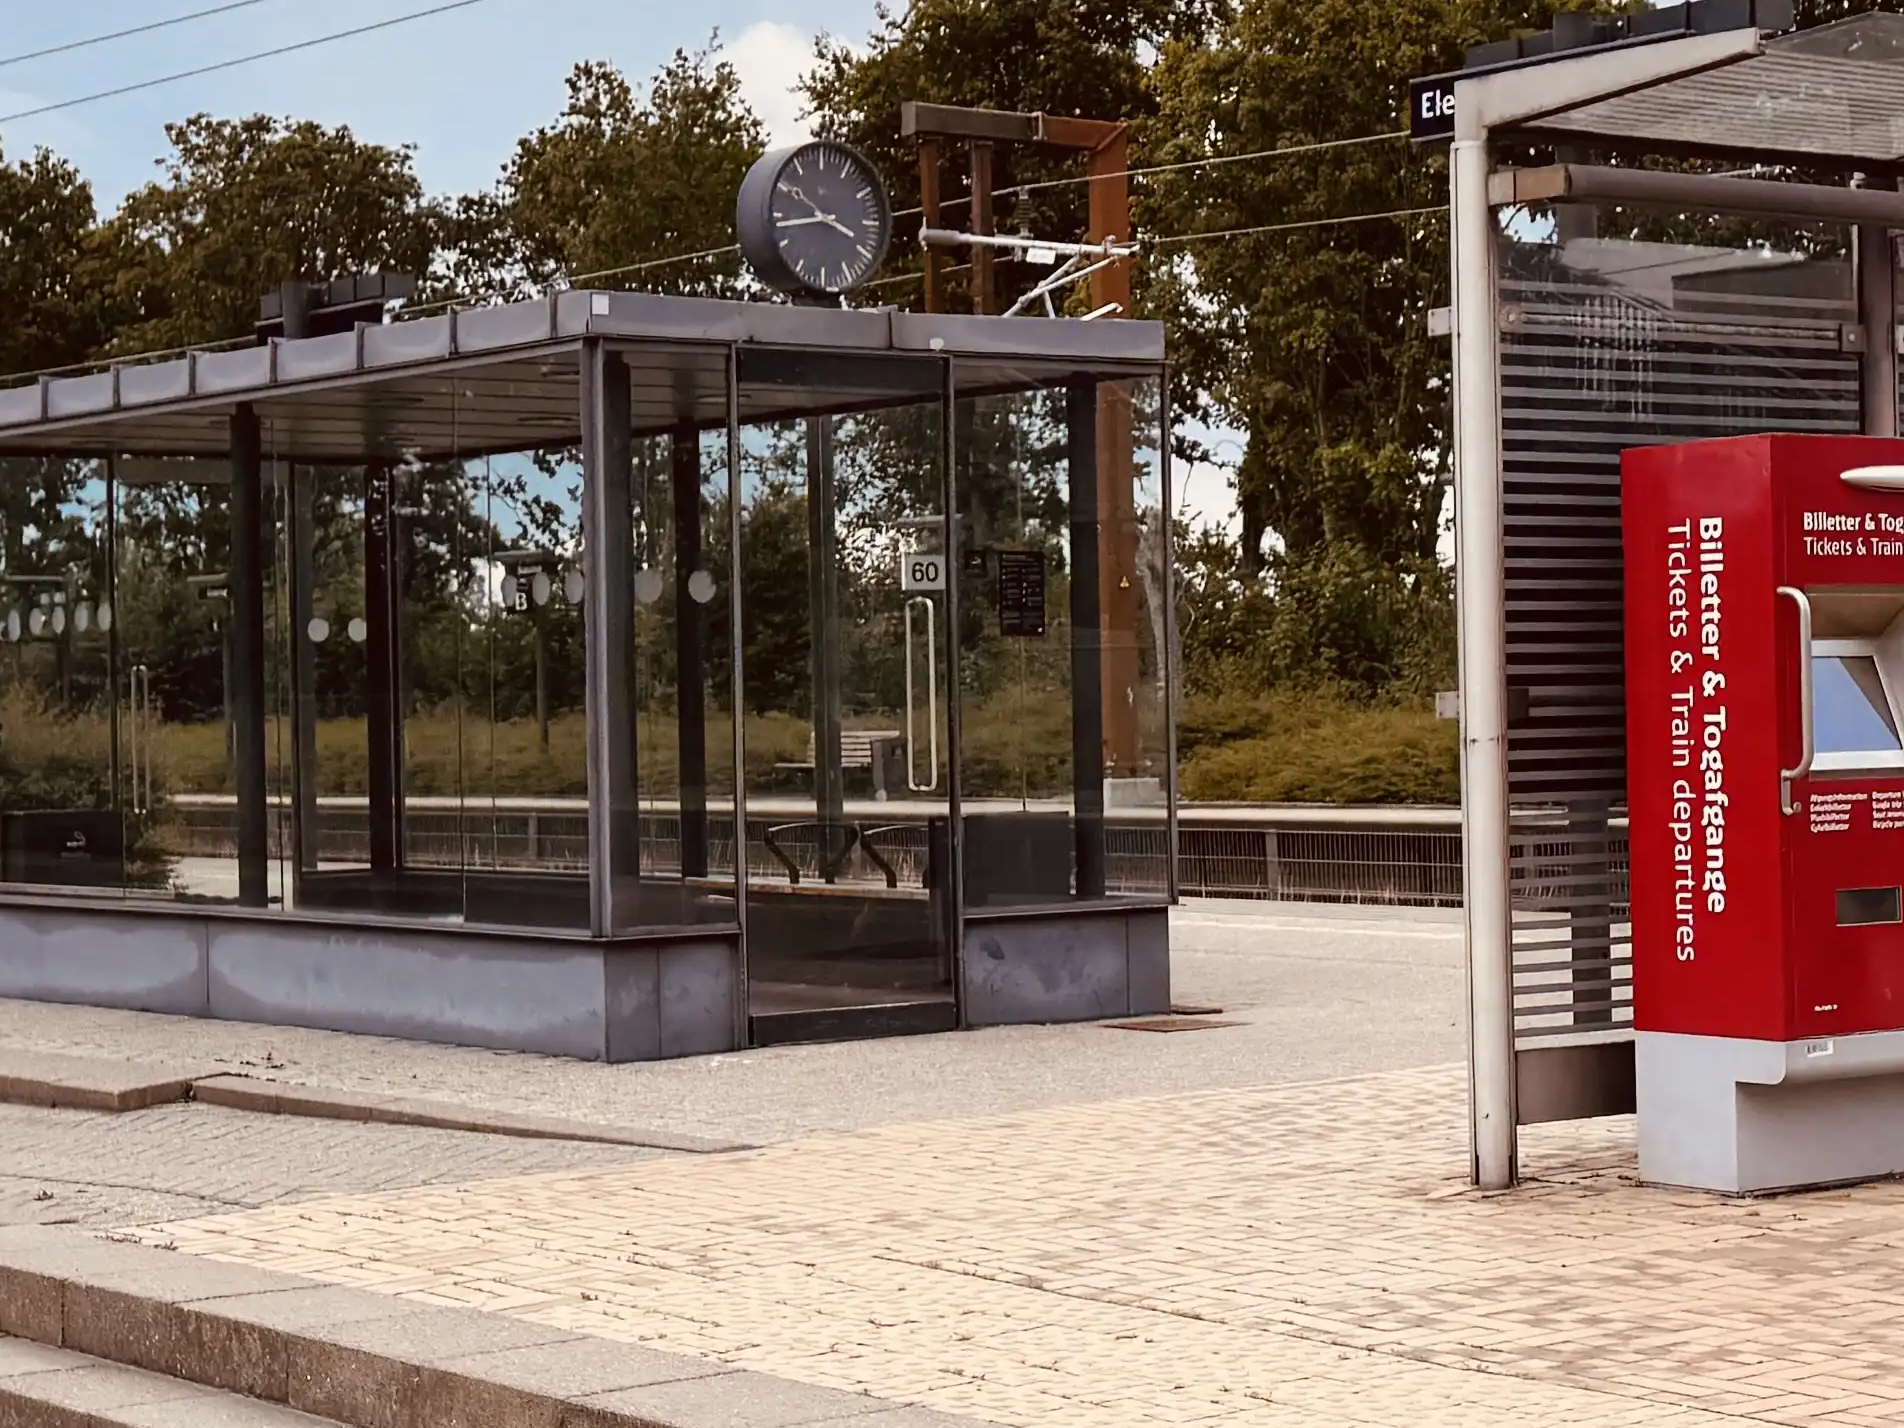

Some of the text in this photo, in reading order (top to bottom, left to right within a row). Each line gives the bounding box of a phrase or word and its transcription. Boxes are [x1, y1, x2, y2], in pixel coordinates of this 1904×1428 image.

[1803, 512, 1862, 532] Billetter
[1864, 512, 1876, 532] &
[1803, 536, 1853, 556] Tickets
[1856, 536, 1867, 556] &
[1870, 537, 1903, 556] Train
[911, 561, 939, 583] 60
[1699, 516, 1729, 913] Billetter & Togafgange
[1667, 517, 1697, 962] Tickets & Train departures
